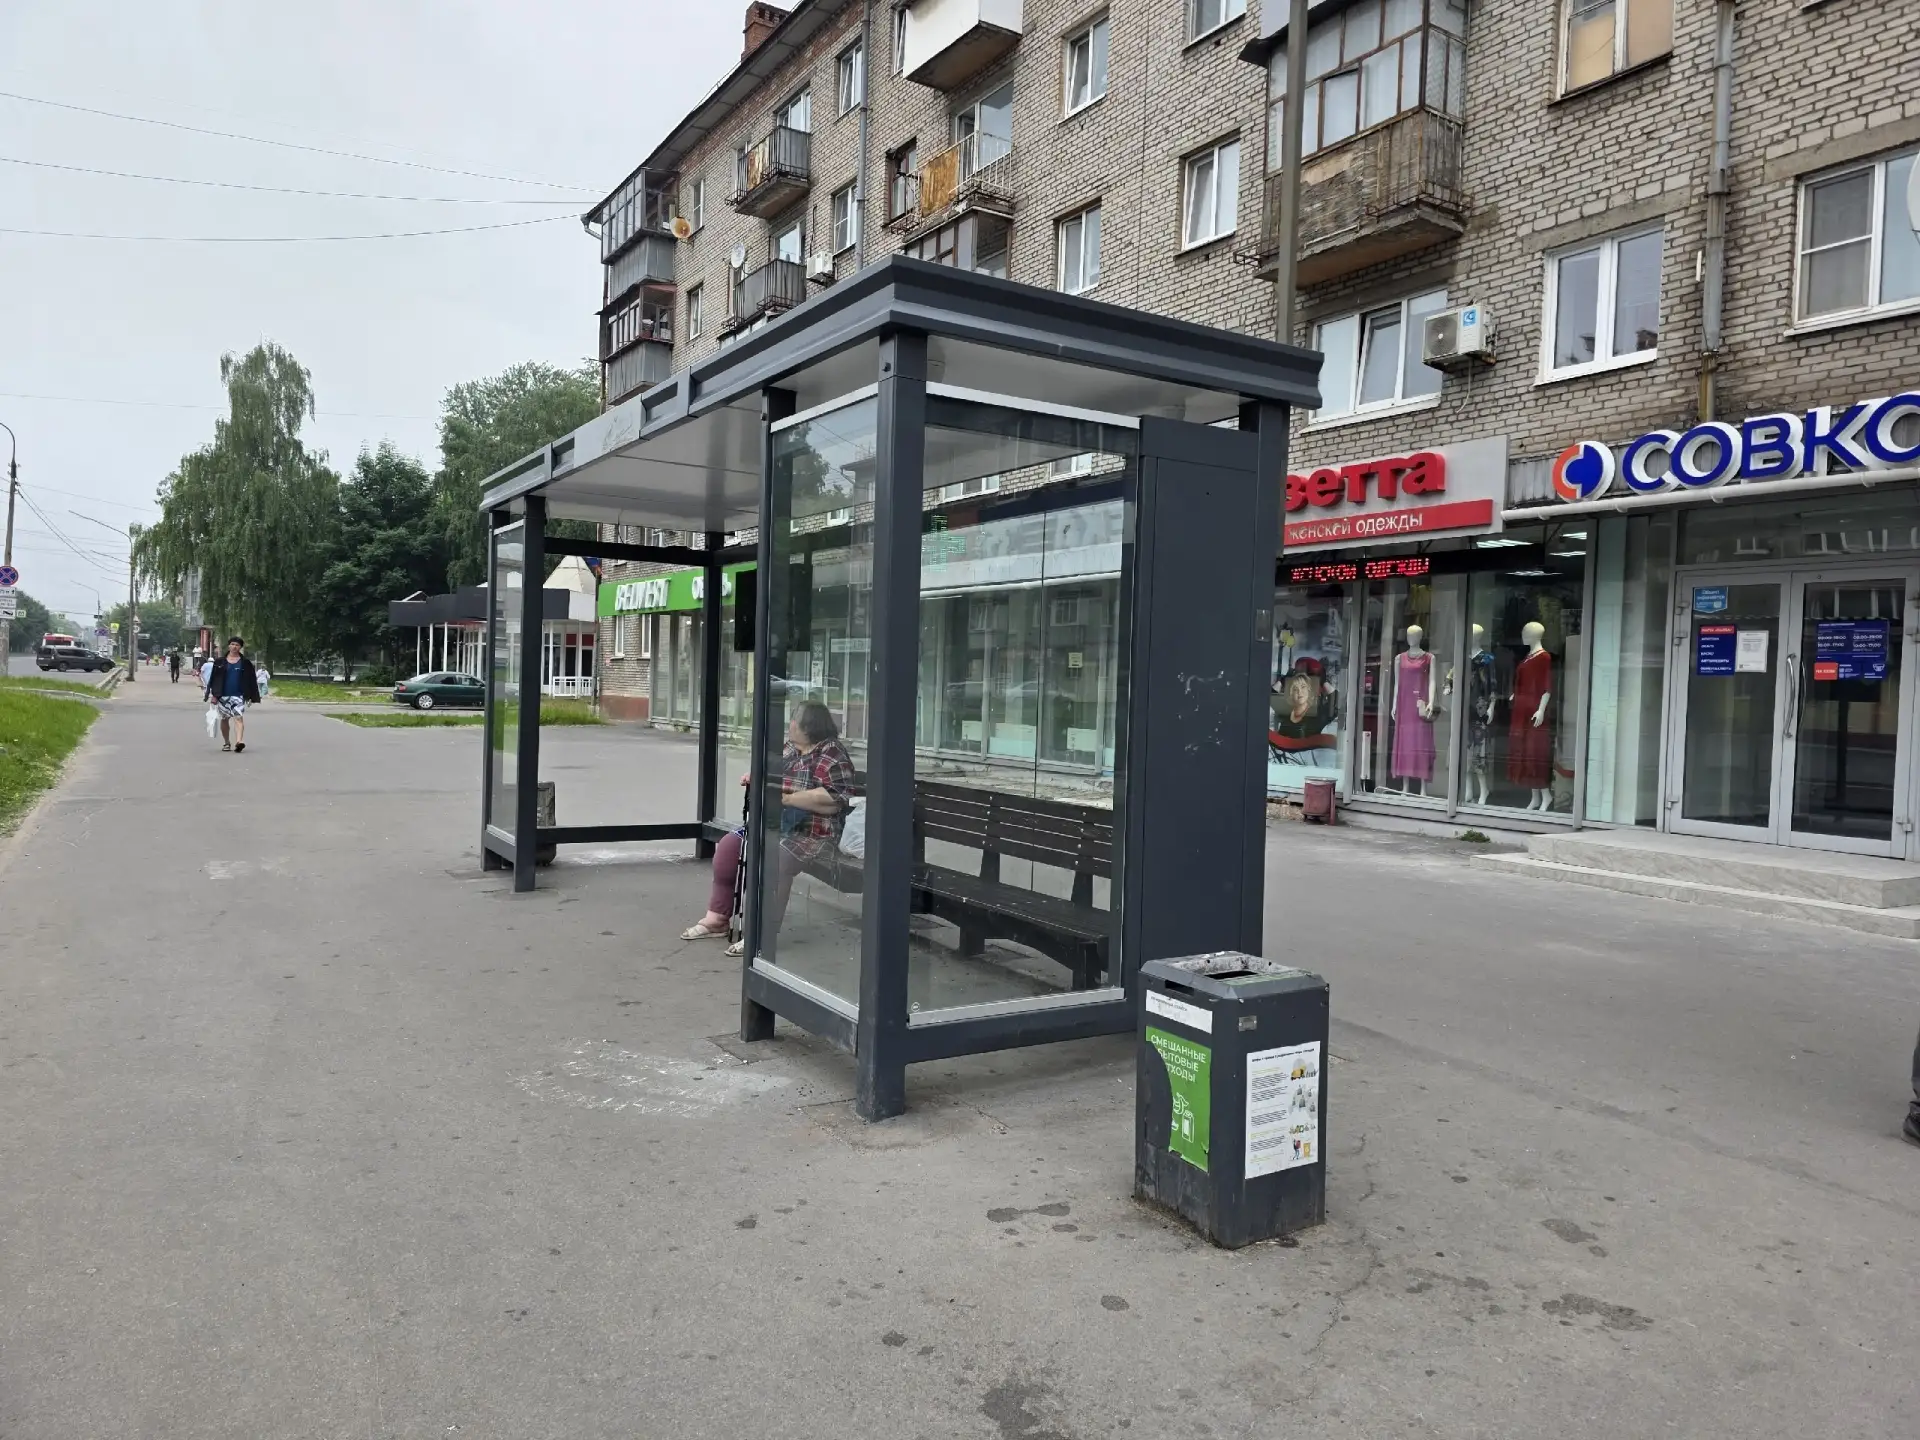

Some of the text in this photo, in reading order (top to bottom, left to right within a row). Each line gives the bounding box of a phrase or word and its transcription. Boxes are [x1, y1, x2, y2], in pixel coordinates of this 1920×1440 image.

[1622, 391, 1920, 494] СОВКО
[1355, 512, 1423, 535] одежды
[1150, 1034, 1207, 1064] СМЕШАННЫЕ
[1165, 1062, 1196, 1083] ТХОДЫ
